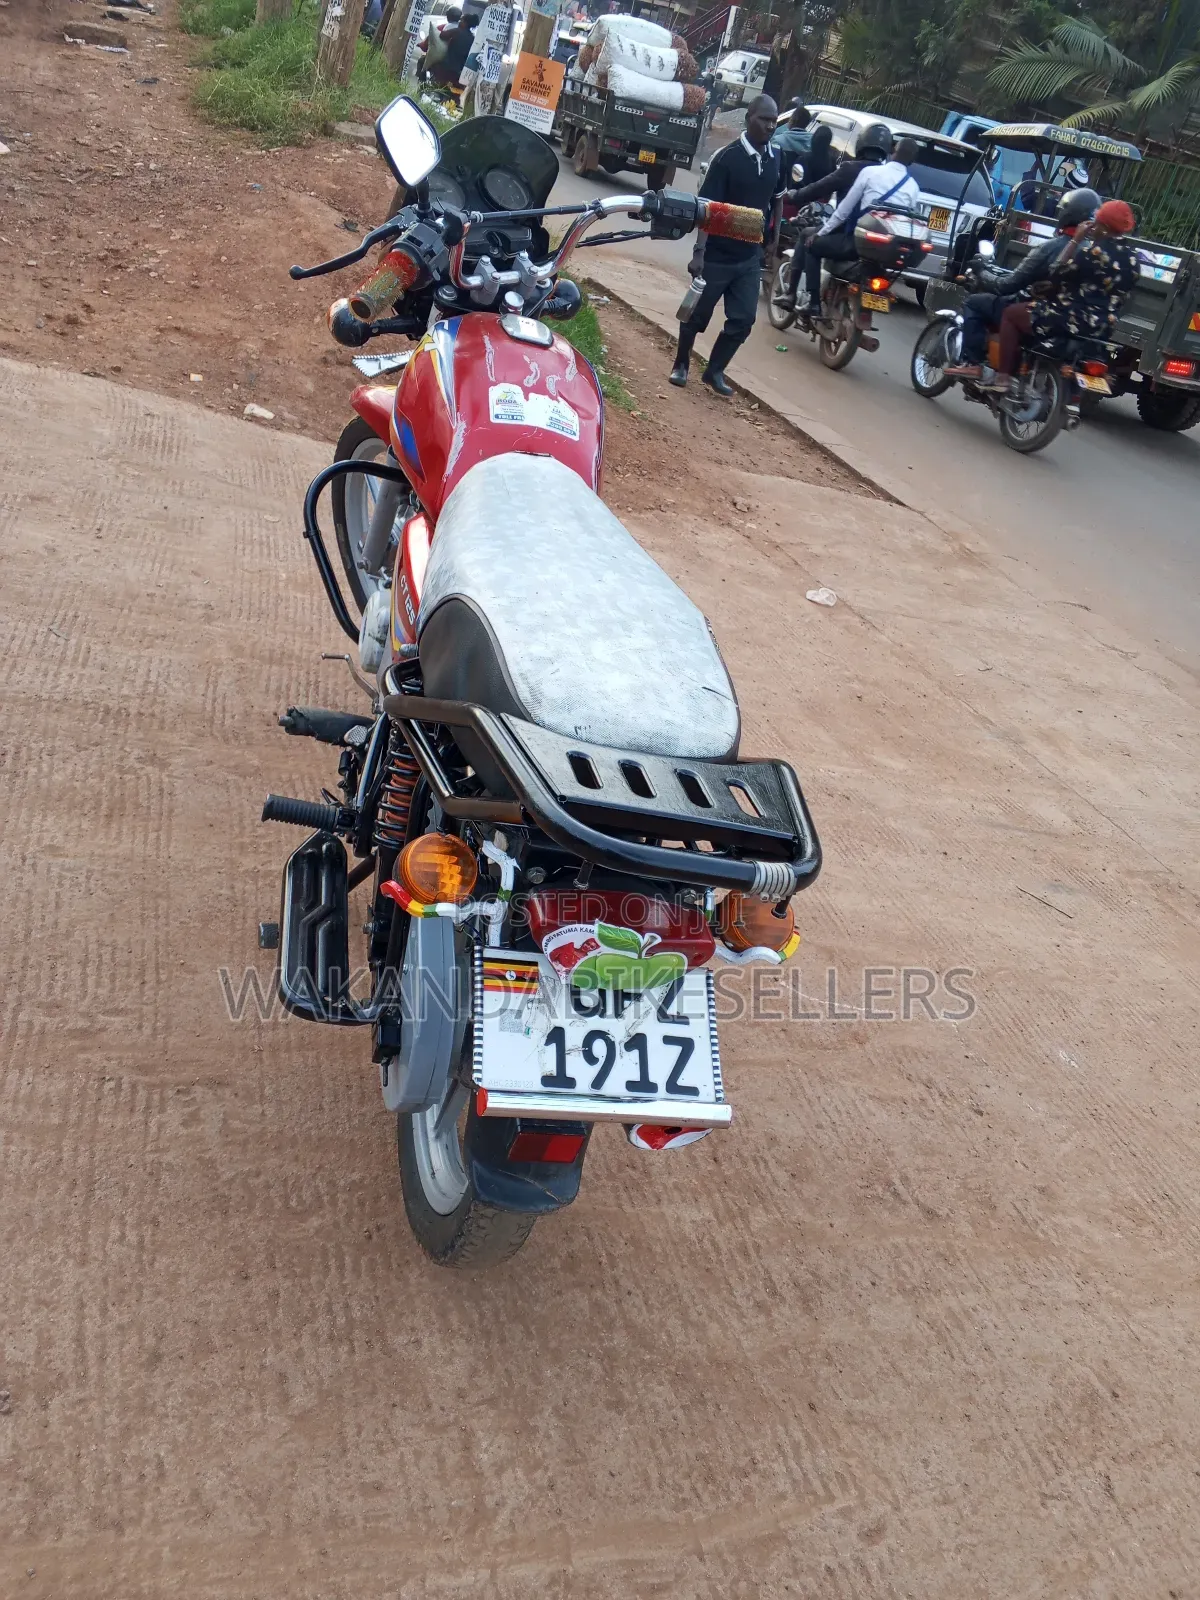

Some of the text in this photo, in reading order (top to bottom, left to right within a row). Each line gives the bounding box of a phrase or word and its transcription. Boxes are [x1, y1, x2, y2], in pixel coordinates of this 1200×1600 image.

[520, 85, 550, 97] INTERNET
[1050, 129, 1077, 145] FAHAD
[404, 594, 416, 626] 125
[540, 1026, 700, 1097] 191Z
